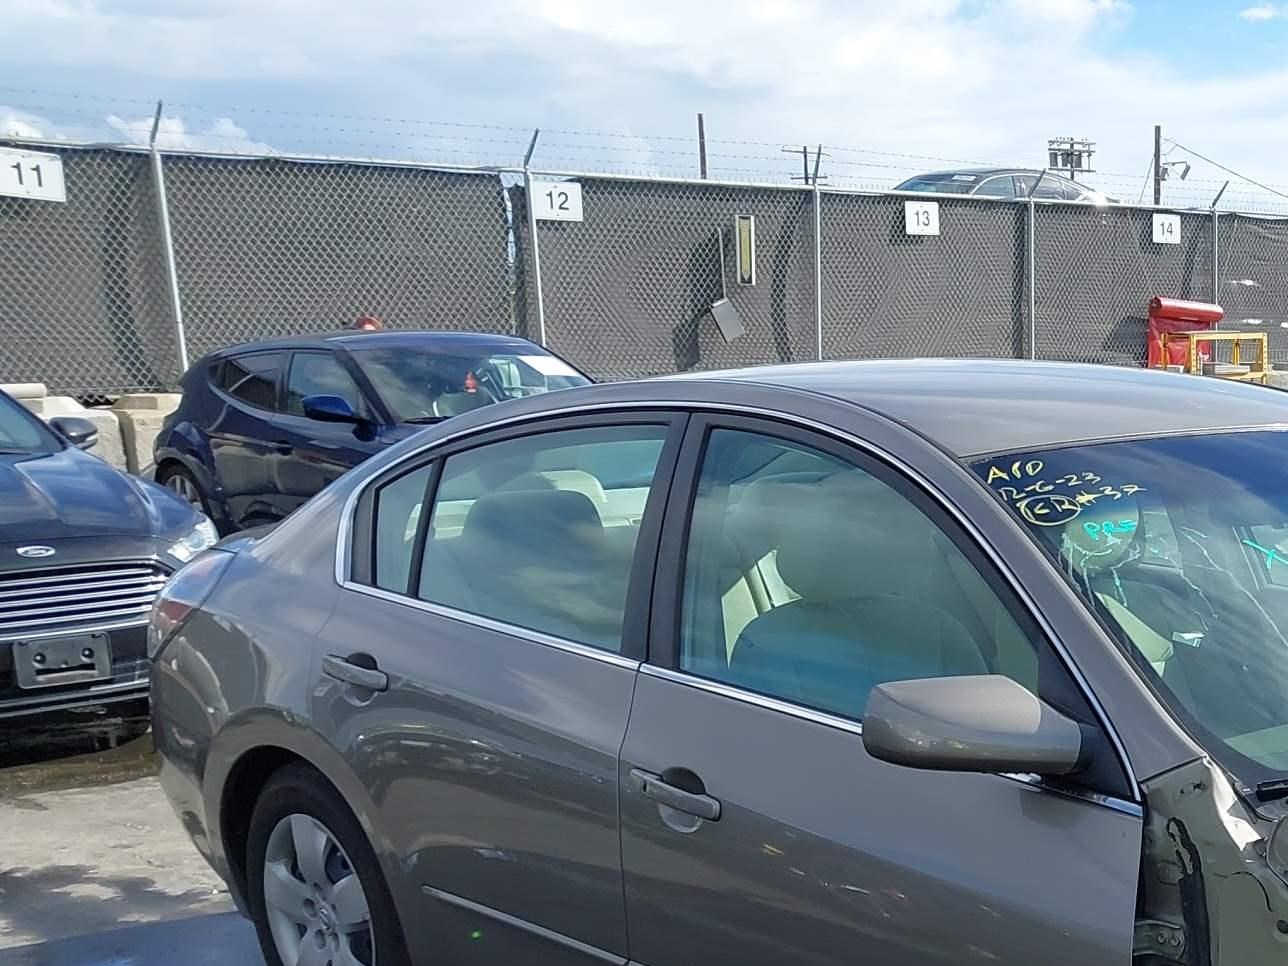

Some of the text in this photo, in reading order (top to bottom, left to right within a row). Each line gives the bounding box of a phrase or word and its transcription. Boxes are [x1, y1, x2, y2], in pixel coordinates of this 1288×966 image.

[10, 162, 43, 188] 11
[545, 190, 570, 211] 12
[913, 210, 931, 227] 13
[1160, 221, 1174, 236] 14
